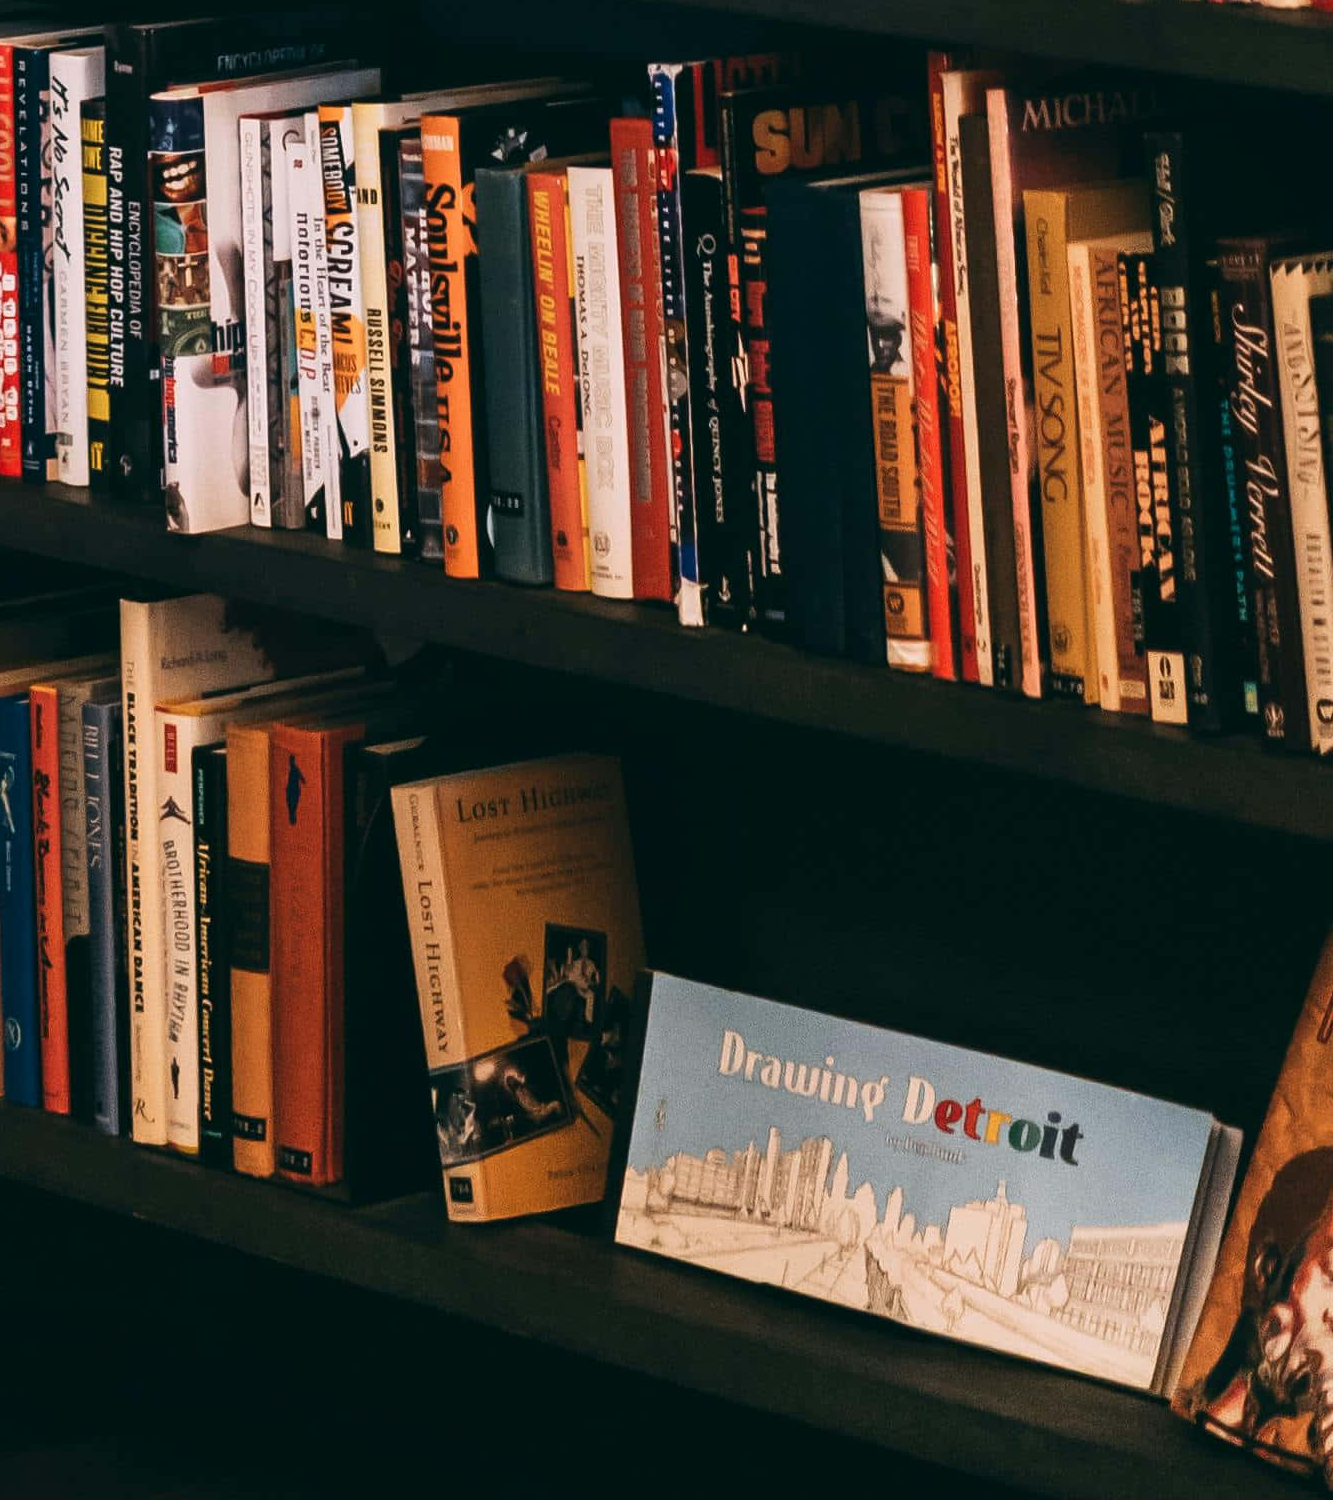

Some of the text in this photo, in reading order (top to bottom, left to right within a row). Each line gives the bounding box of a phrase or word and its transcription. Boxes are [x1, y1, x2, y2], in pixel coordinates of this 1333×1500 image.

[366, 309, 388, 452] RUSSELL SIMMONS
[719, 1030, 1085, 1169] Drawing Detroit
